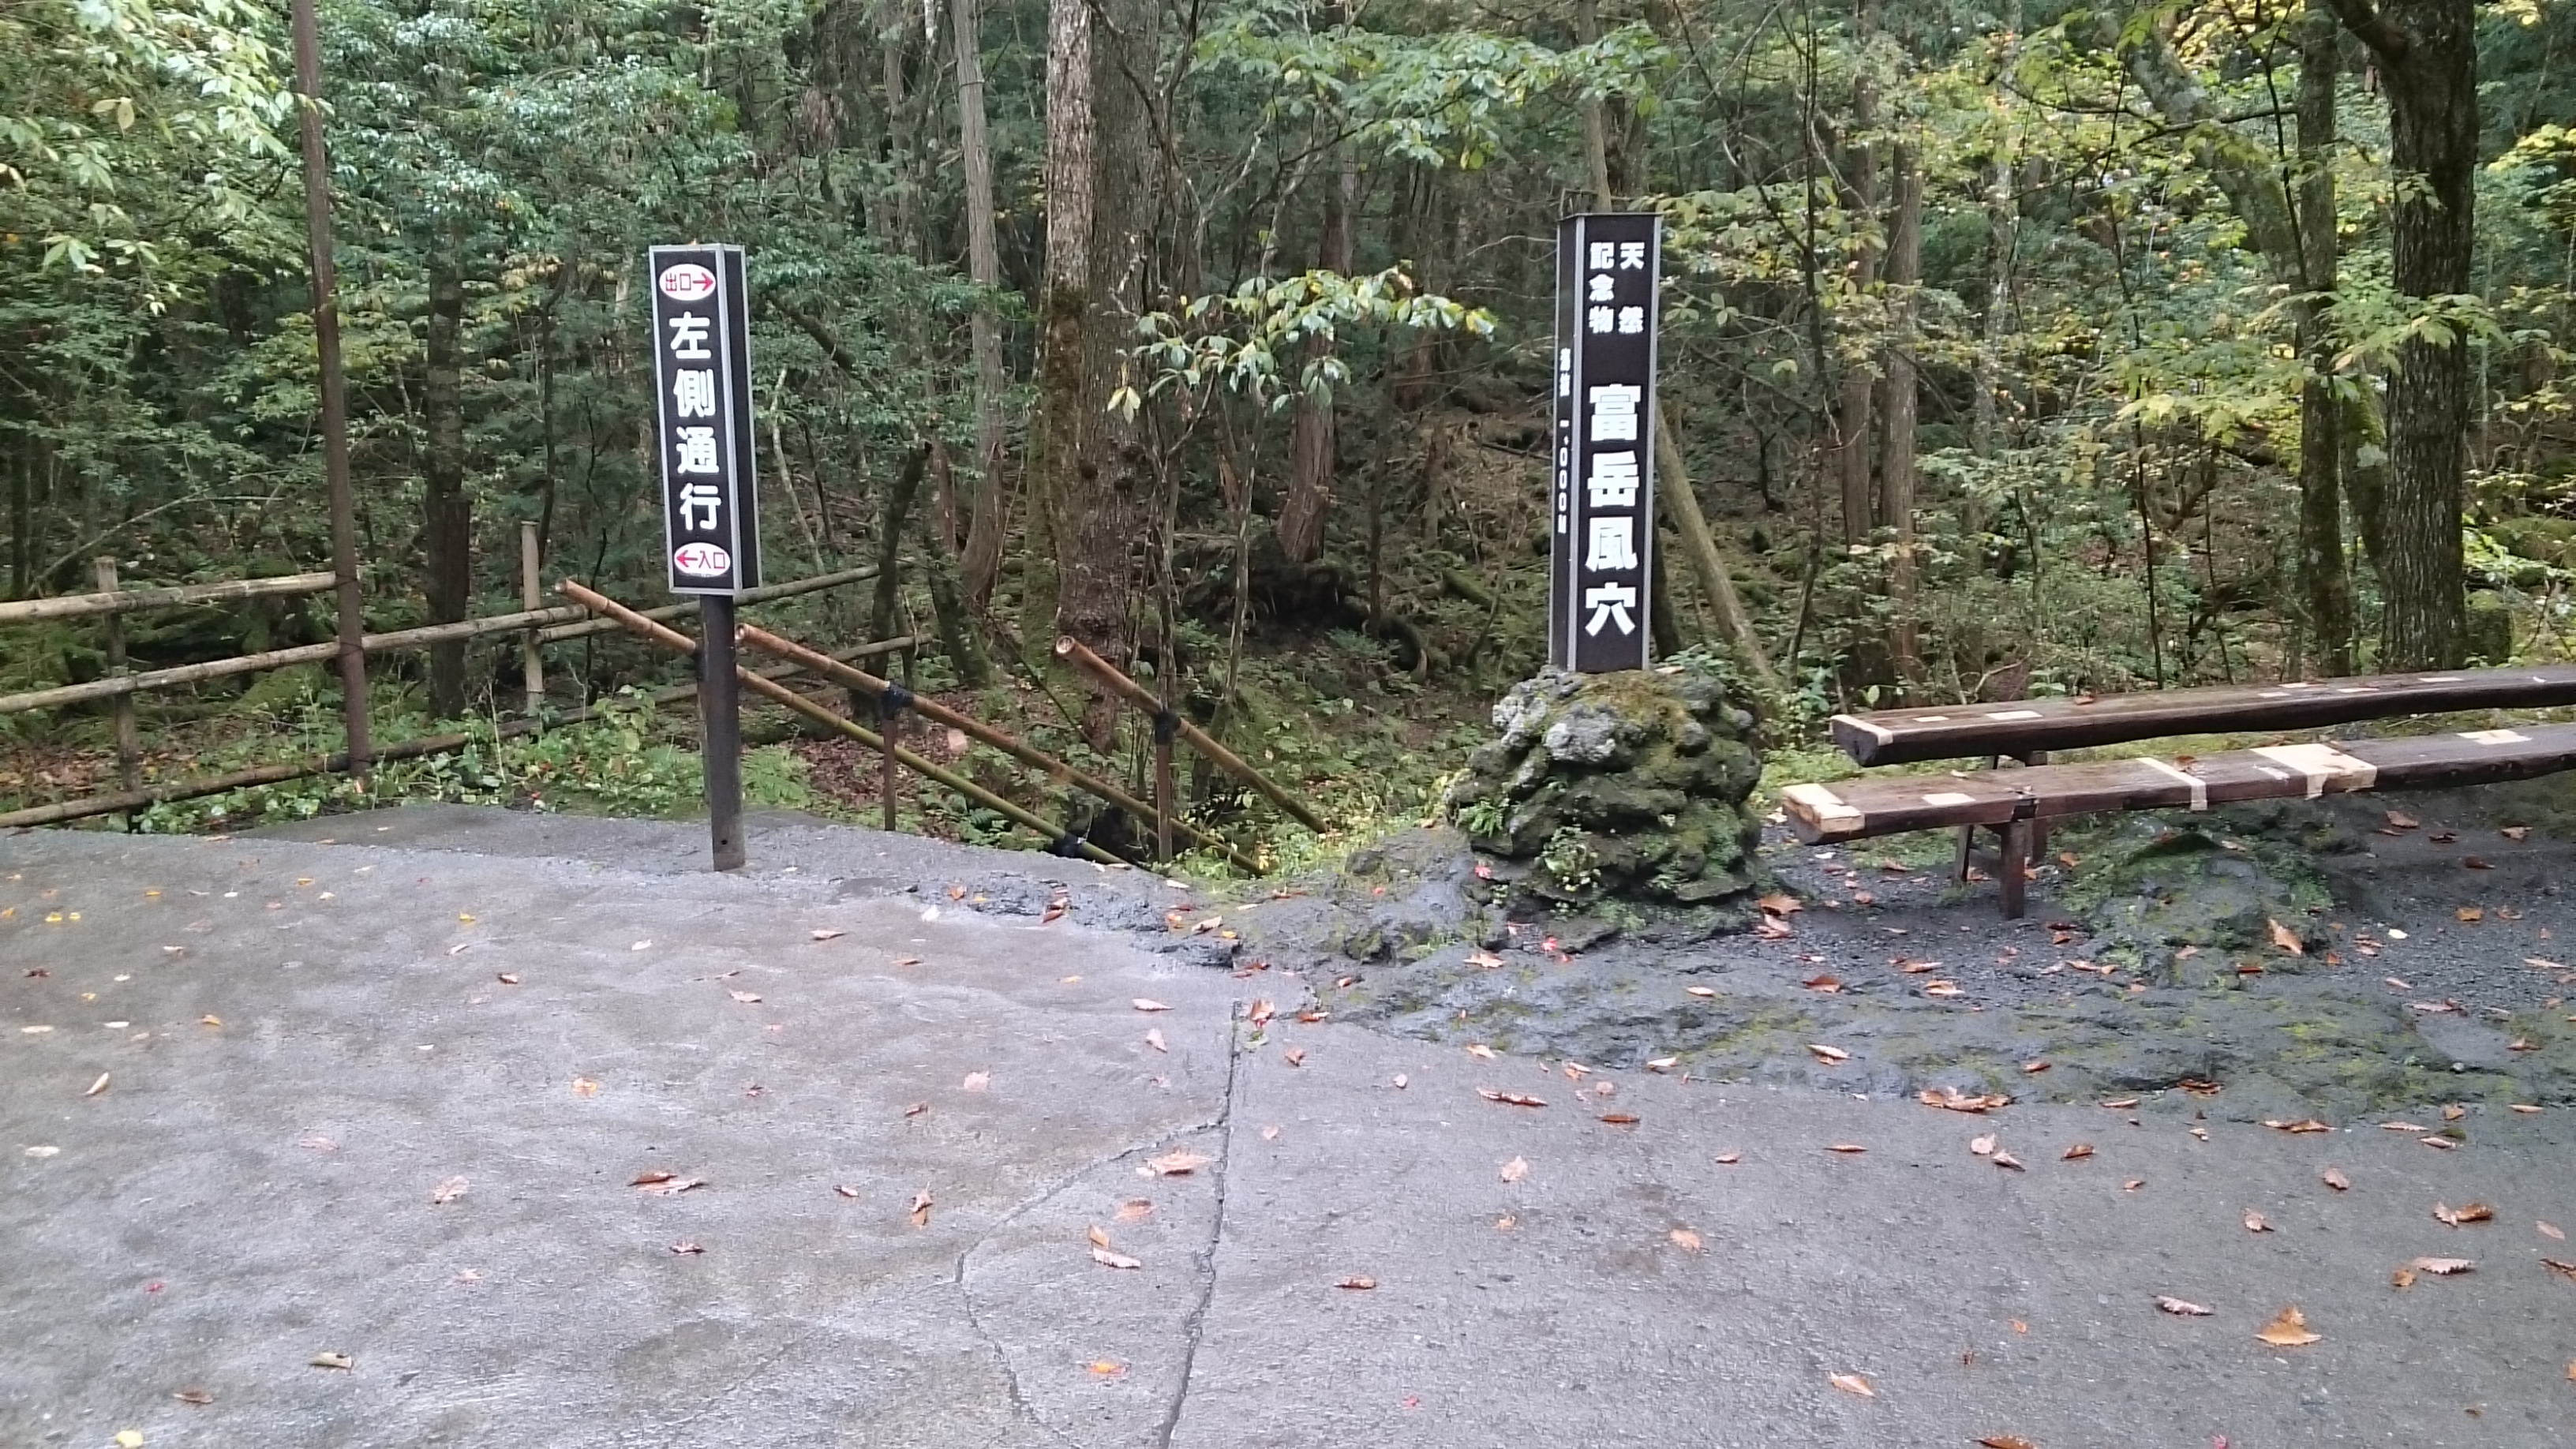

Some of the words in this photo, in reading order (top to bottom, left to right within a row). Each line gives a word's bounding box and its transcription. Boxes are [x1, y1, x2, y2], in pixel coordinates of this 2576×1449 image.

[665, 272, 691, 292] 出口
[1589, 242, 1614, 333] 記念物
[1619, 242, 1644, 333] 天然
[669, 311, 721, 530] 左側通行
[1585, 384, 1642, 636] 富岳風穴
[698, 550, 725, 569] 入口
